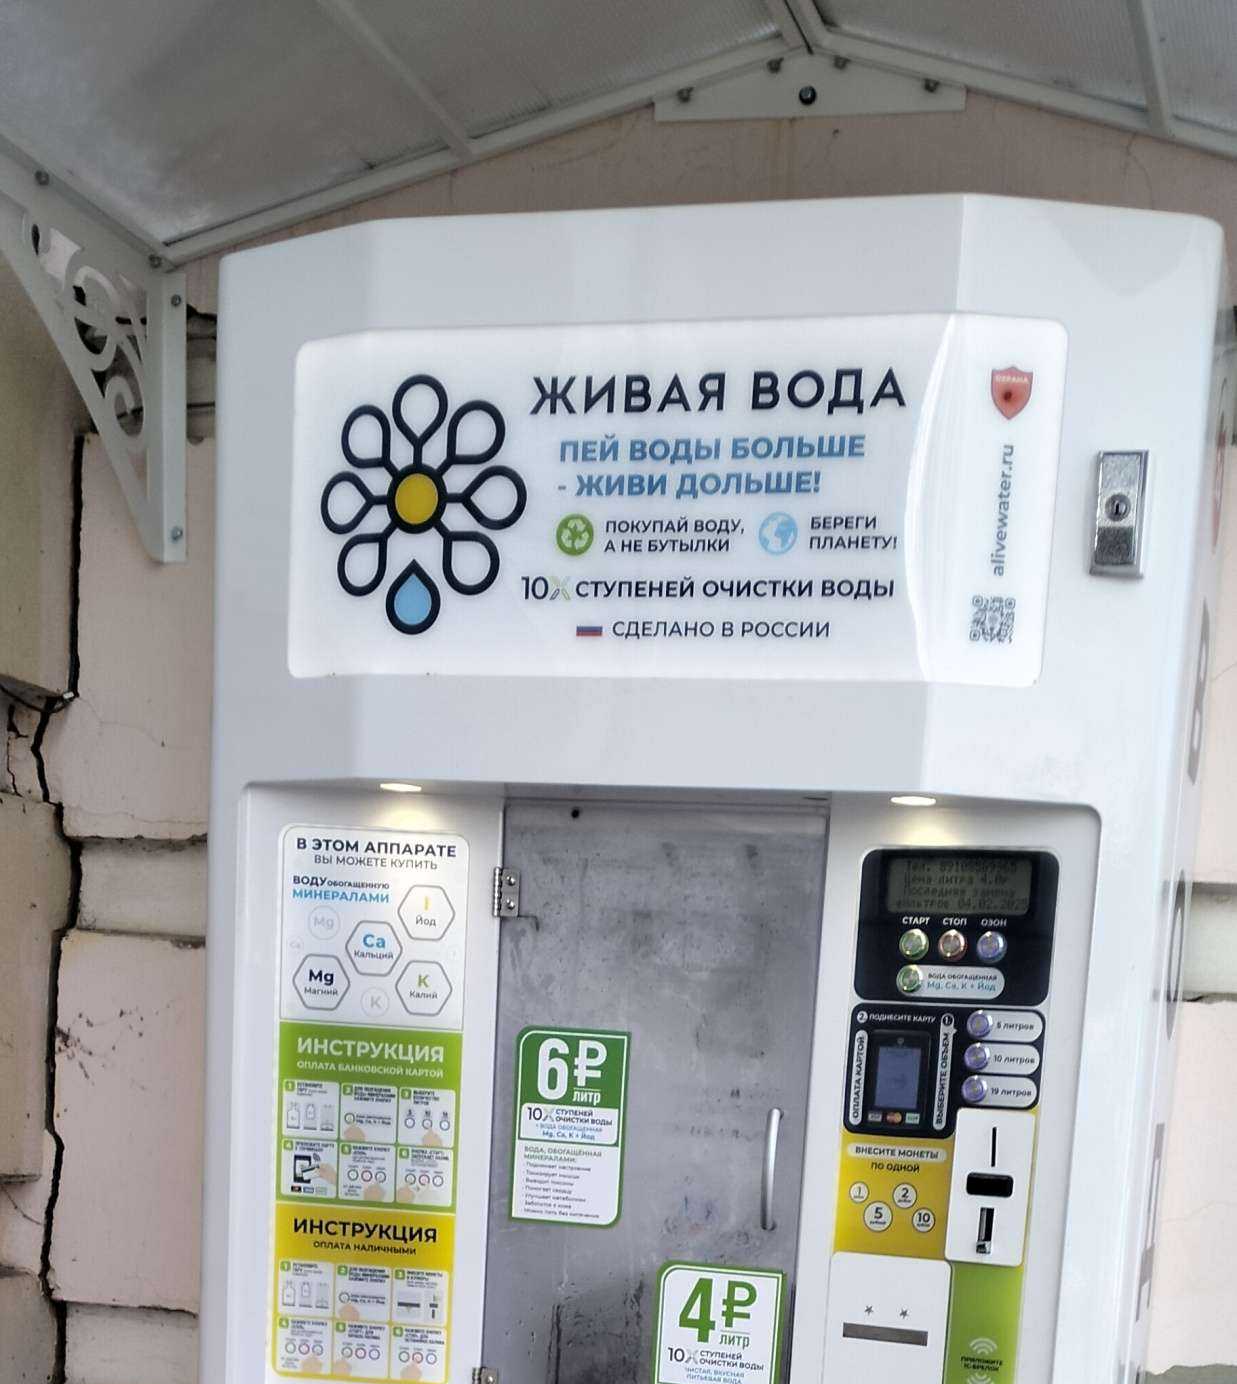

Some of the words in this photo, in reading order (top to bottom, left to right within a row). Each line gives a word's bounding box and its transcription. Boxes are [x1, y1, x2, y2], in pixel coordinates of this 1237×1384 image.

[530, 371, 726, 415] ЖИВАЯ
[751, 367, 907, 415] ВОДА
[559, 434, 619, 462] ПЕЙ
[629, 437, 721, 464] ВОДЫ
[731, 434, 866, 460] БОЛЬШЕ
[575, 472, 667, 498] ЖИВИ
[675, 471, 821, 500] ДОЛЬШЕ!
[991, 444, 1014, 577] alivewater.ru
[605, 516, 689, 534] ПОКУПАЙ
[694, 518, 745, 535] ВОДУ,
[810, 515, 877, 531] БЕРЕГИ
[604, 539, 615, 553] А
[620, 539, 643, 553] НЕ
[648, 538, 730, 553] БУТЫЛКИ
[808, 534, 898, 551] ПЛАНЕТУ!
[575, 577, 695, 599] СТУПЕНЕЙ
[702, 578, 813, 599] ОЧИСТКИ
[821, 579, 895, 601] ВОДЫ
[612, 620, 715, 640] СДЕЛАНО
[721, 621, 734, 638] В
[741, 620, 831, 639] РОССИИ
[297, 837, 307, 850] В
[312, 838, 359, 853] ЭТОМ
[364, 841, 457, 858] АППАРАТЕ
[314, 855, 332, 865] ВЫ
[336, 856, 387, 868] МОЖЕТЕ
[390, 858, 438, 870] КУПИТЬ
[293, 875, 327, 887] ВОДУ
[292, 889, 389, 903] МИНЕРАЛАМИ
[313, 916, 334, 930] Mg
[415, 914, 437, 927] Йод
[902, 916, 930, 926] СТАРТ
[942, 917, 967, 926] СТОП
[980, 918, 1007, 927] ОЗОН
[362, 934, 386, 949] Ca
[354, 949, 394, 960] Кальций
[308, 969, 334, 986] Mg
[304, 987, 339, 997] Магний
[409, 990, 438, 1000] Калий
[869, 1013, 911, 1022] ПОДНЕСИТЕ
[1003, 1023, 1034, 1031] литров
[297, 1037, 444, 1063] ИНСТРУКЦИЯ
[856, 1035, 865, 1076] КАРТОЙ
[1004, 1056, 1035, 1064] литров
[297, 1060, 336, 1071] ОПЛАТА
[338, 1063, 403, 1075] БАНКОВСКОЙ
[406, 1068, 443, 1078] КАРТОЙ
[573, 1091, 601, 1106] литр
[853, 1078, 863, 1118] ОПЛАТА
[936, 1070, 947, 1125] ВЫБЕРИТЕ
[1001, 1089, 1032, 1097] литров
[555, 1108, 593, 1117] СТУПЕНЕЙ
[555, 1116, 589, 1124] ОЧИСТКИ
[855, 1146, 896, 1156] ВНЕСИТЕ
[898, 1148, 938, 1159] МОНЕТЫ
[871, 1162, 884, 1170] ПО
[886, 1162, 920, 1173] ОДНОЙ
[901, 1187, 909, 1198] 2
[874, 1207, 883, 1220] 5
[917, 1212, 931, 1223] 10
[293, 1218, 437, 1243] ИНСТРУКЦИЯ
[313, 1240, 351, 1250] ОПЛАТА
[353, 1243, 416, 1255] НАЛИЧНЫМИ
[719, 1333, 750, 1350] литр
[700, 1350, 742, 1360] СТУПЕНЕЙ
[700, 1358, 738, 1367] ОЧИСТКИ
[739, 1363, 764, 1371] ВОДЫ
